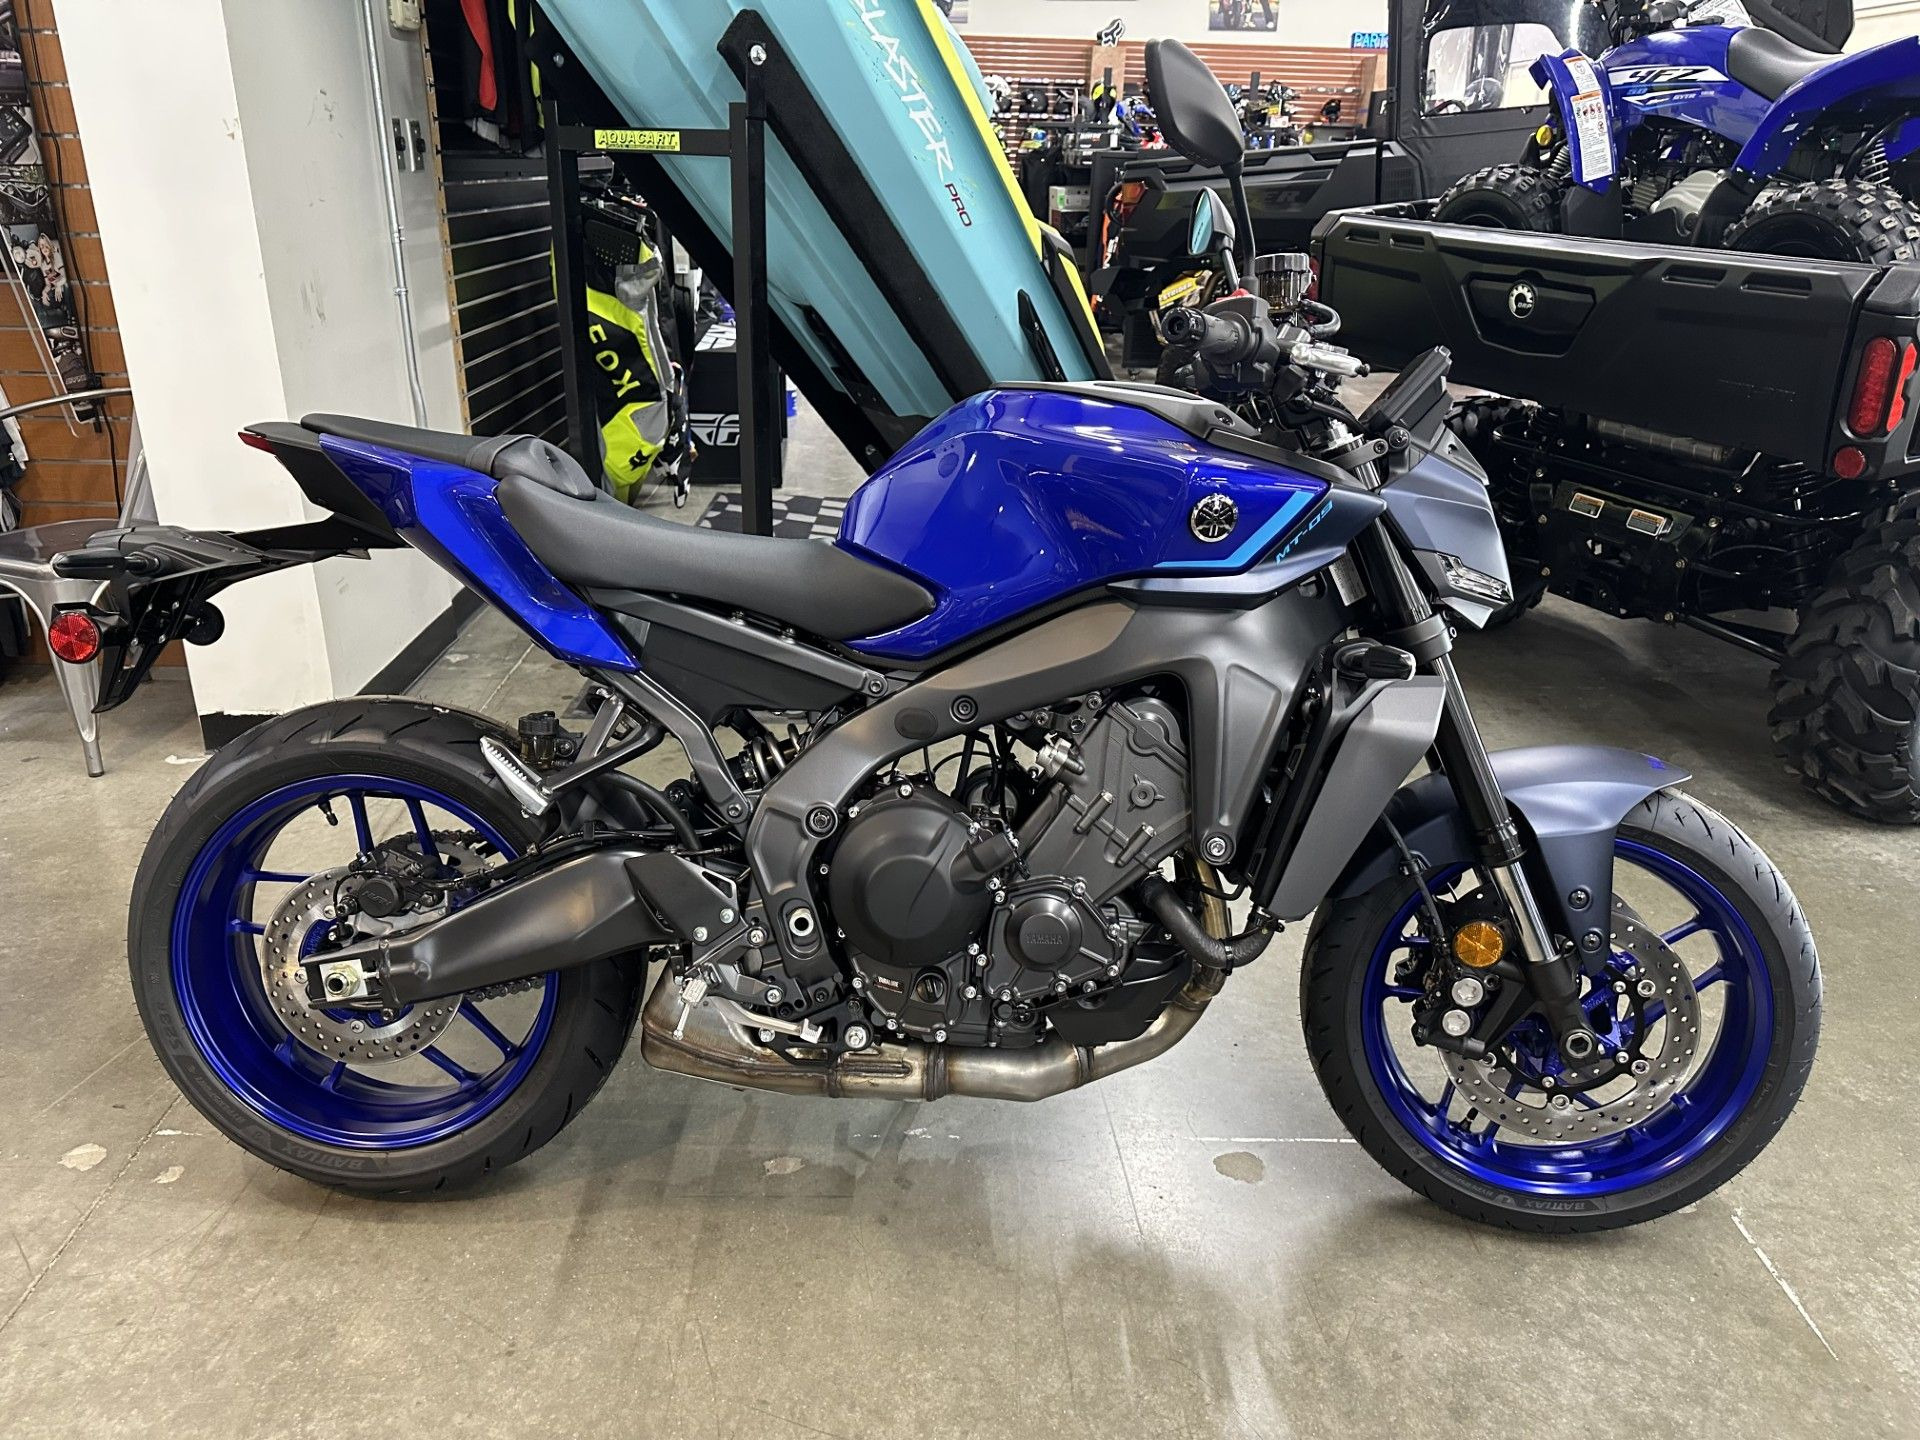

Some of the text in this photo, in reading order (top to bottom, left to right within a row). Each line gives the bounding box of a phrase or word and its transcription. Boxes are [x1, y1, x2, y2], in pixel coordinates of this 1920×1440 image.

[598, 132, 675, 145] AQUACART
[945, 183, 972, 227] PRO
[588, 324, 640, 398] FOX
[1276, 500, 1333, 566] MT-09
[1026, 932, 1063, 945] YAMAHA
